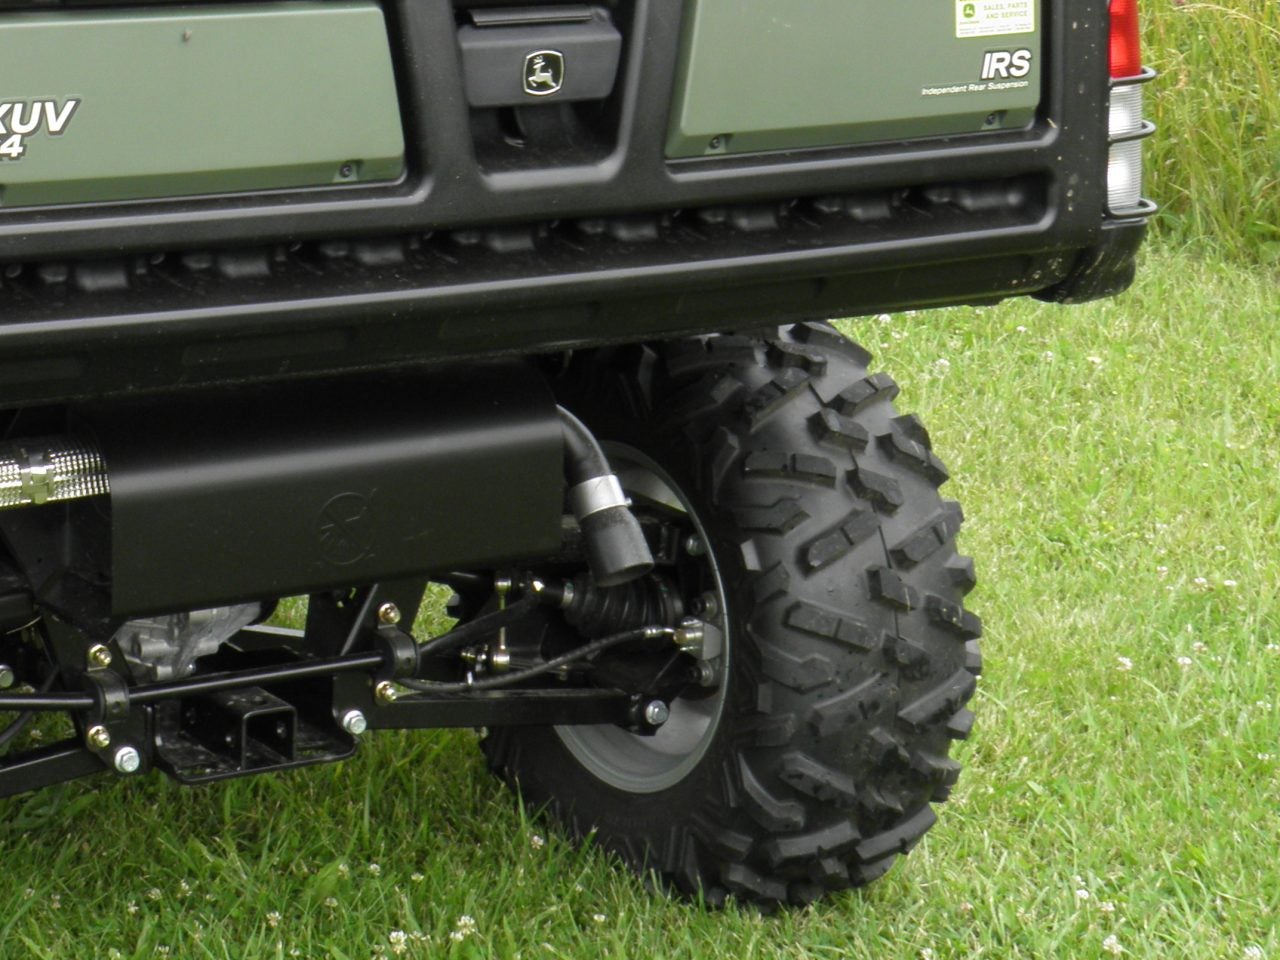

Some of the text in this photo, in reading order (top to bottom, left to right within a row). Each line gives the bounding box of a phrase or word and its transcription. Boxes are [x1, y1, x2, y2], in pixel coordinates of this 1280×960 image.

[1001, 10, 1028, 18] SERVICE
[981, 49, 1032, 80] IRS
[921, 80, 1029, 96] Independent Rear Suspension
